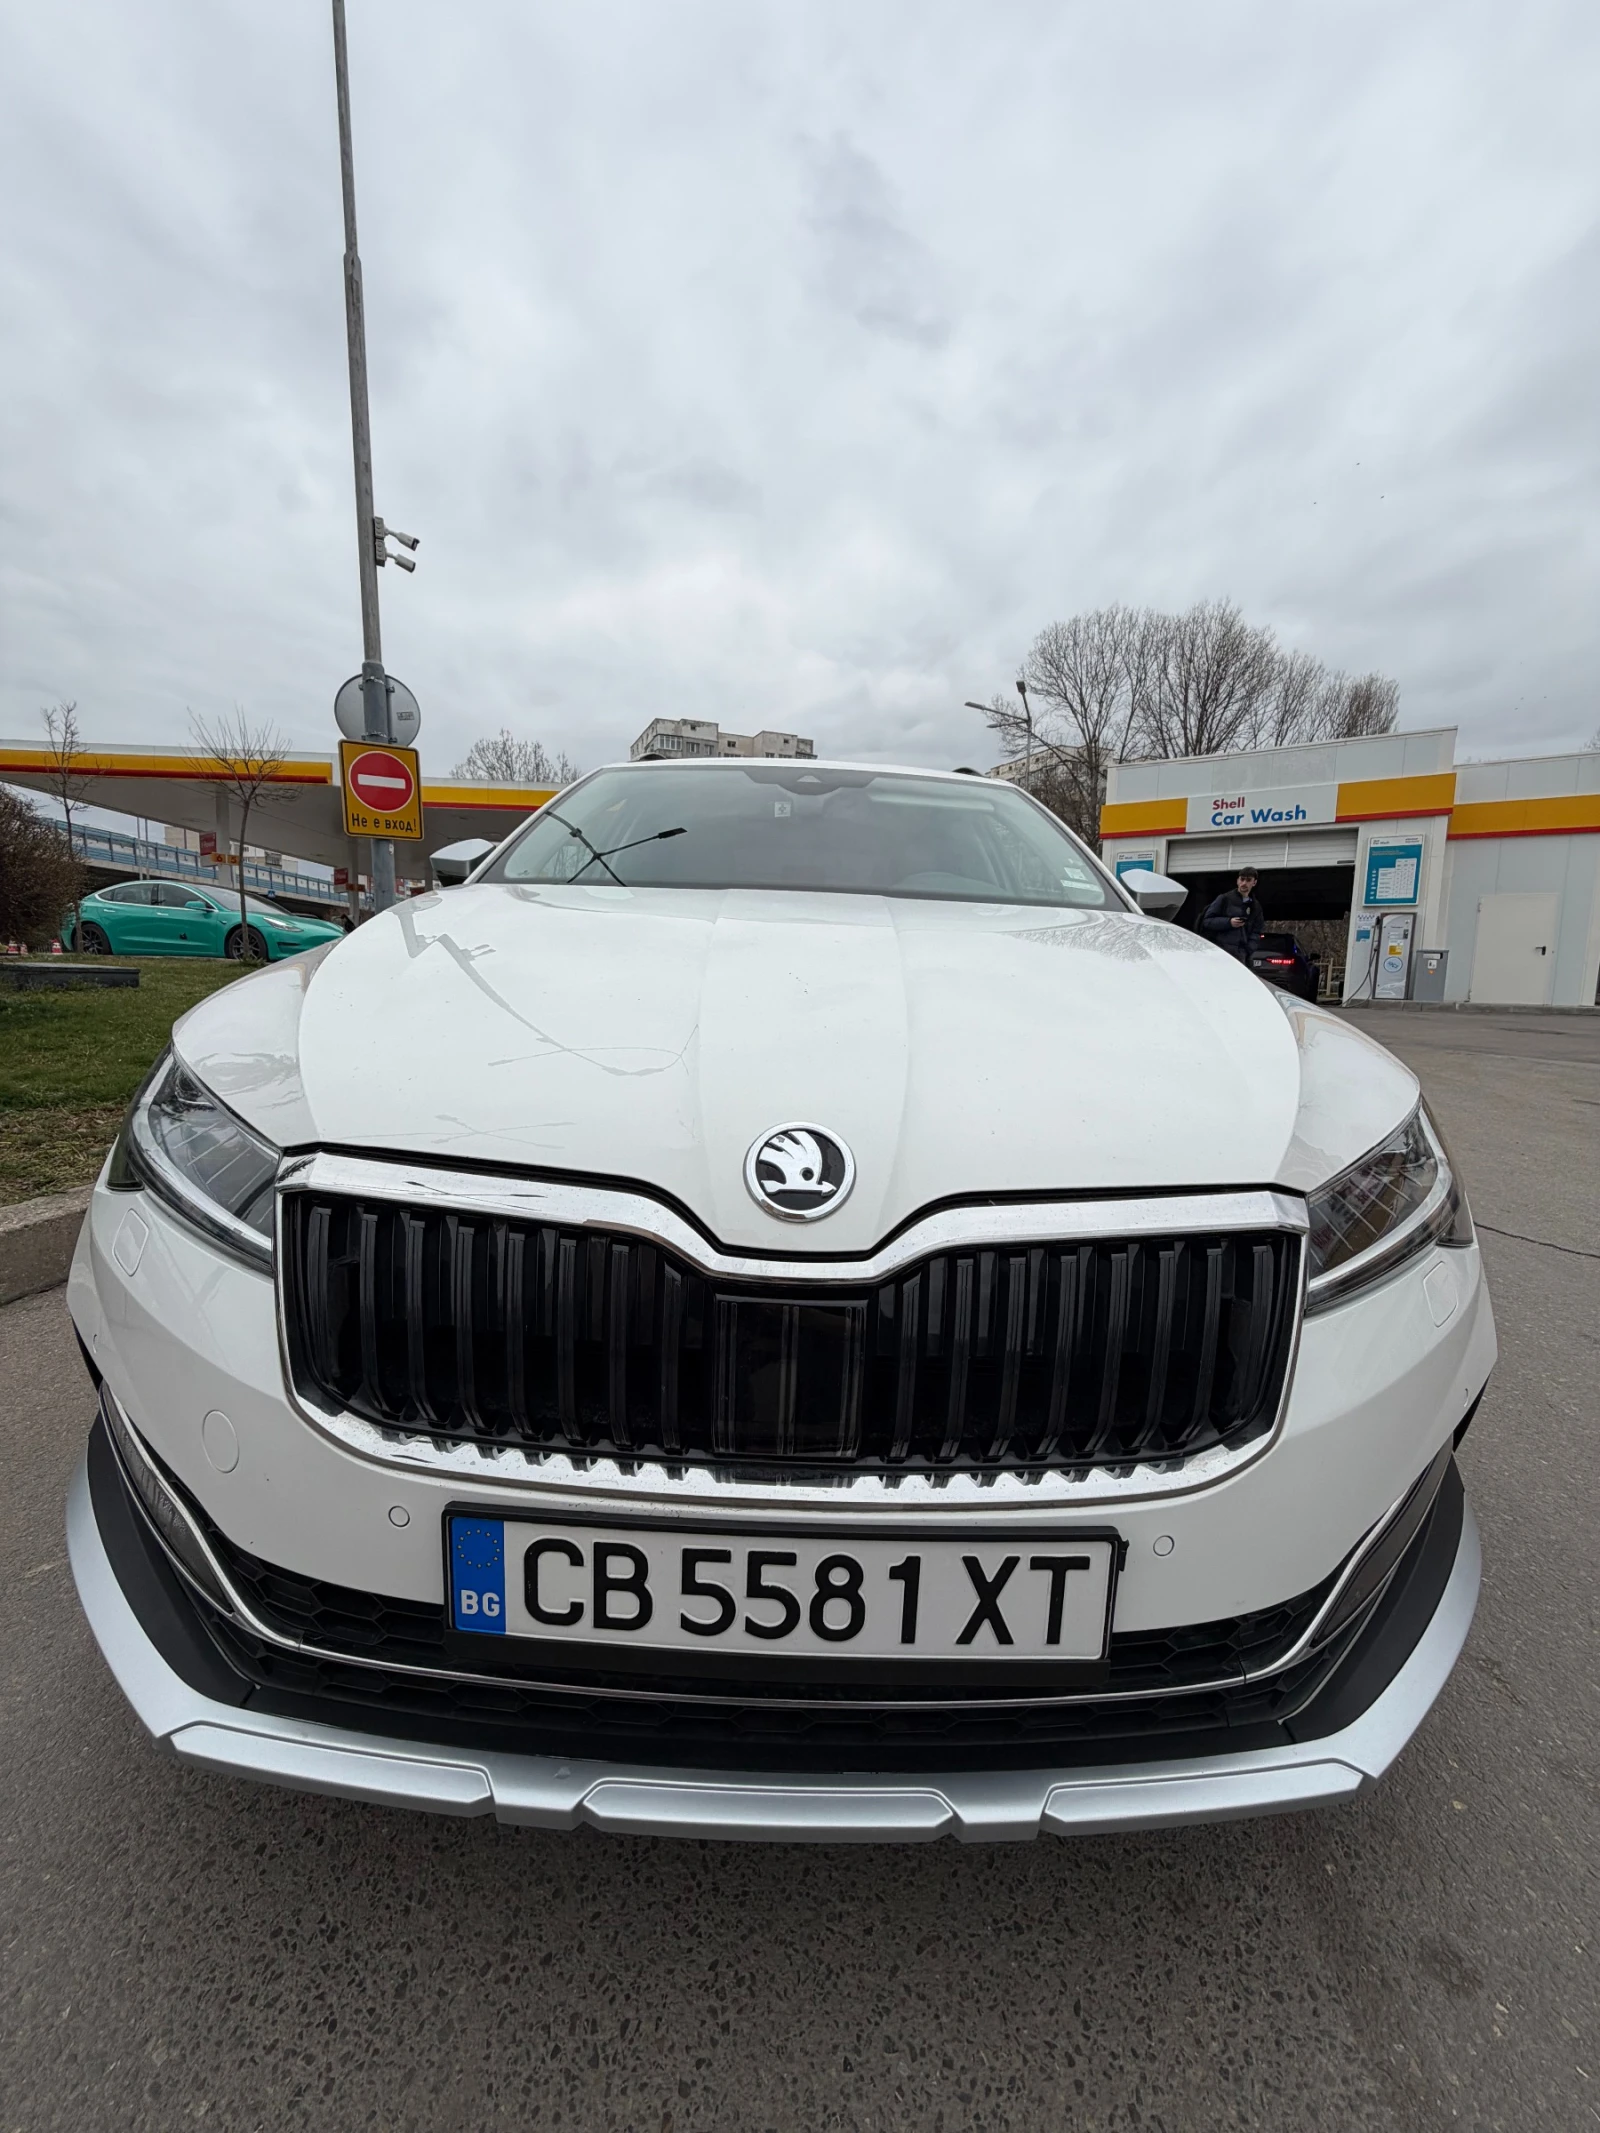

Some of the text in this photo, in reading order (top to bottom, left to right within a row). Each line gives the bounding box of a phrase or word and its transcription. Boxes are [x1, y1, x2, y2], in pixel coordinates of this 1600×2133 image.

[1212, 796, 1245, 810] Shell
[351, 812, 417, 833] Не е вход!
[1211, 804, 1307, 827] Car Wash
[461, 1537, 1091, 1645] BG CB 5581 XT
